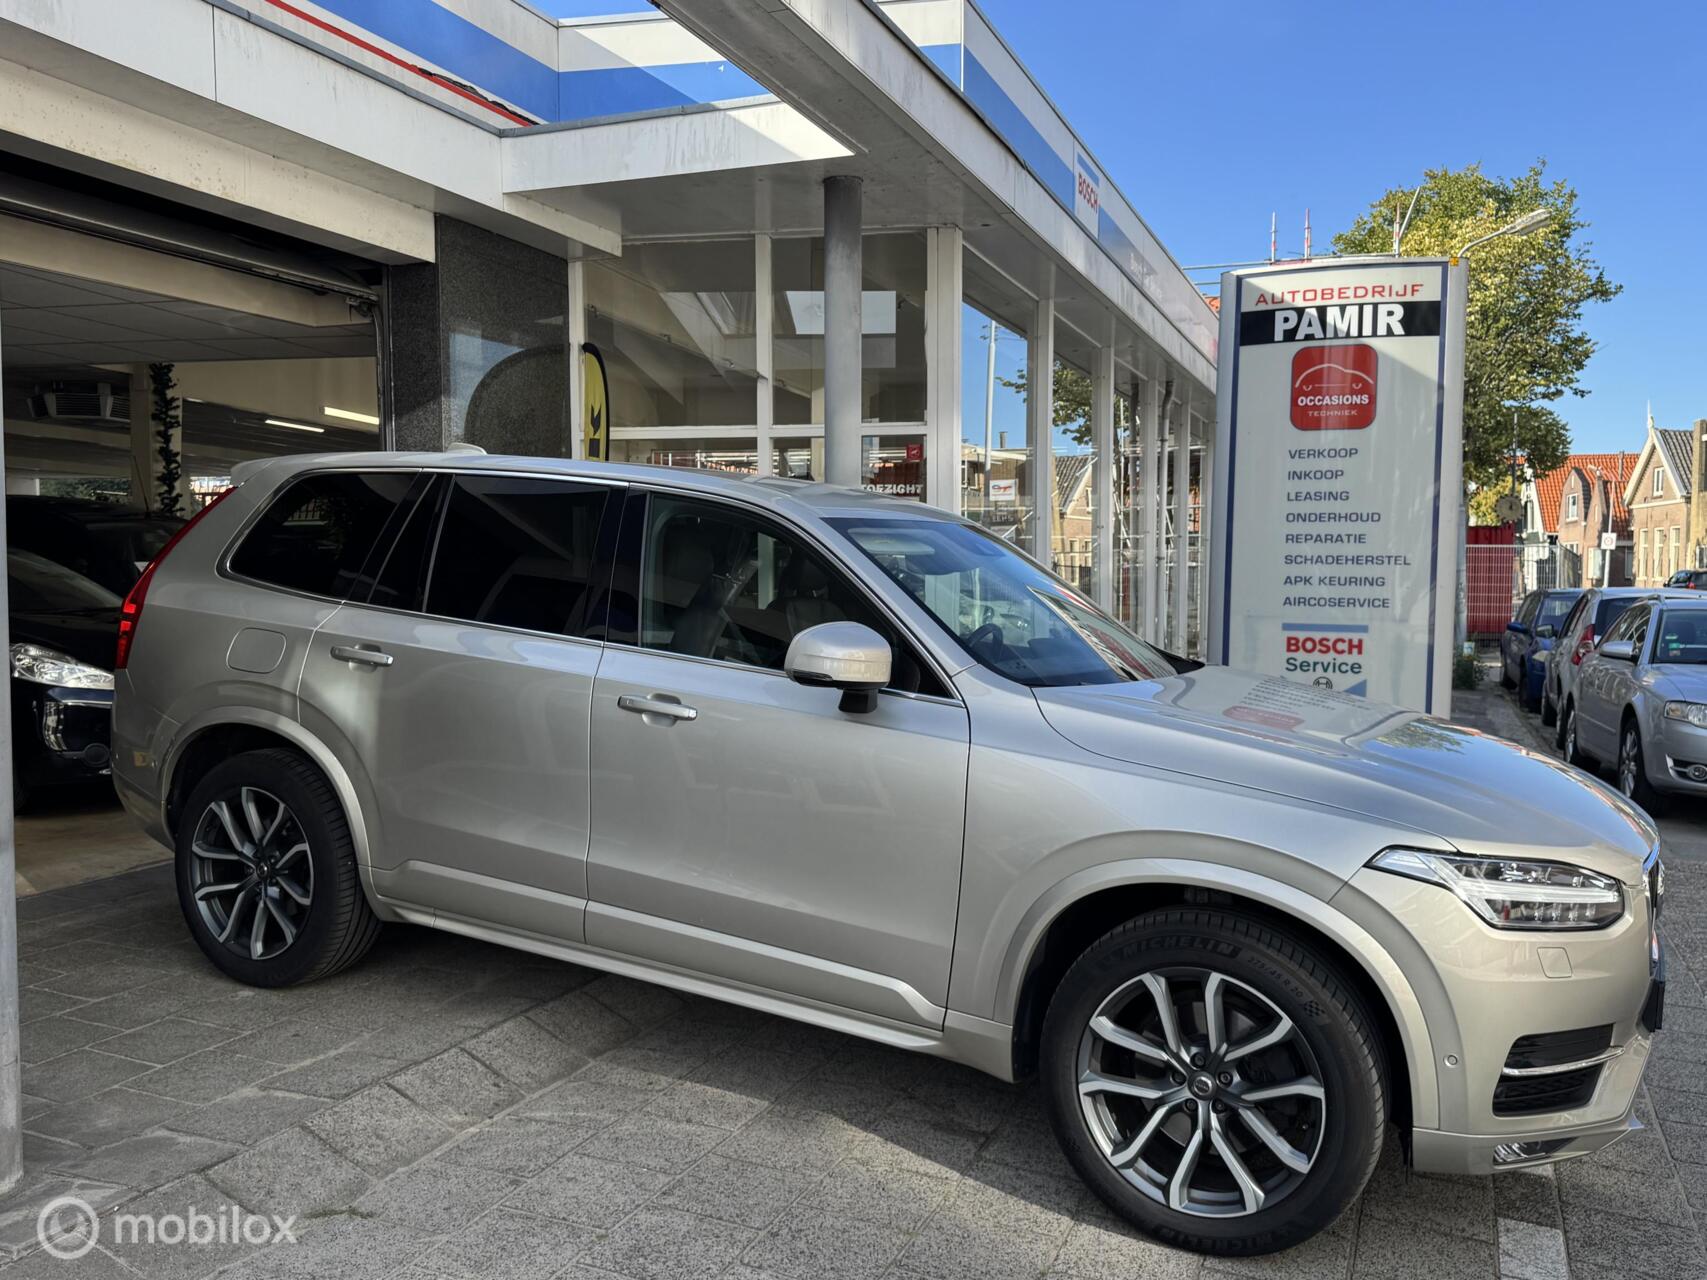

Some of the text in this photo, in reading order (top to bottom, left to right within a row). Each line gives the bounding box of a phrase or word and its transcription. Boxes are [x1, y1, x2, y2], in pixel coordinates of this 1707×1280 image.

[1078, 172, 1098, 214] BOSCH
[1255, 283, 1425, 306] AUTOBEDRIJF
[1273, 303, 1406, 342] PAMIR
[1297, 394, 1370, 407] OCCASIONS
[1307, 409, 1358, 417] TECHNIEK
[1288, 448, 1359, 460] VERKOOP
[1287, 469, 1345, 481] INKOOP
[1286, 490, 1350, 502] LEASING
[1285, 512, 1382, 523] ONDERHOUD
[1284, 533, 1367, 545] REPARATIE
[1283, 554, 1412, 566] SCHADEHERSTEL
[1283, 575, 1386, 587] APK KEURING
[1282, 596, 1391, 609] AIRCOSERVICE
[1285, 636, 1364, 656] BOSCH
[1284, 657, 1363, 674] Service
[1122, 934, 1236, 960] MICHELIN
